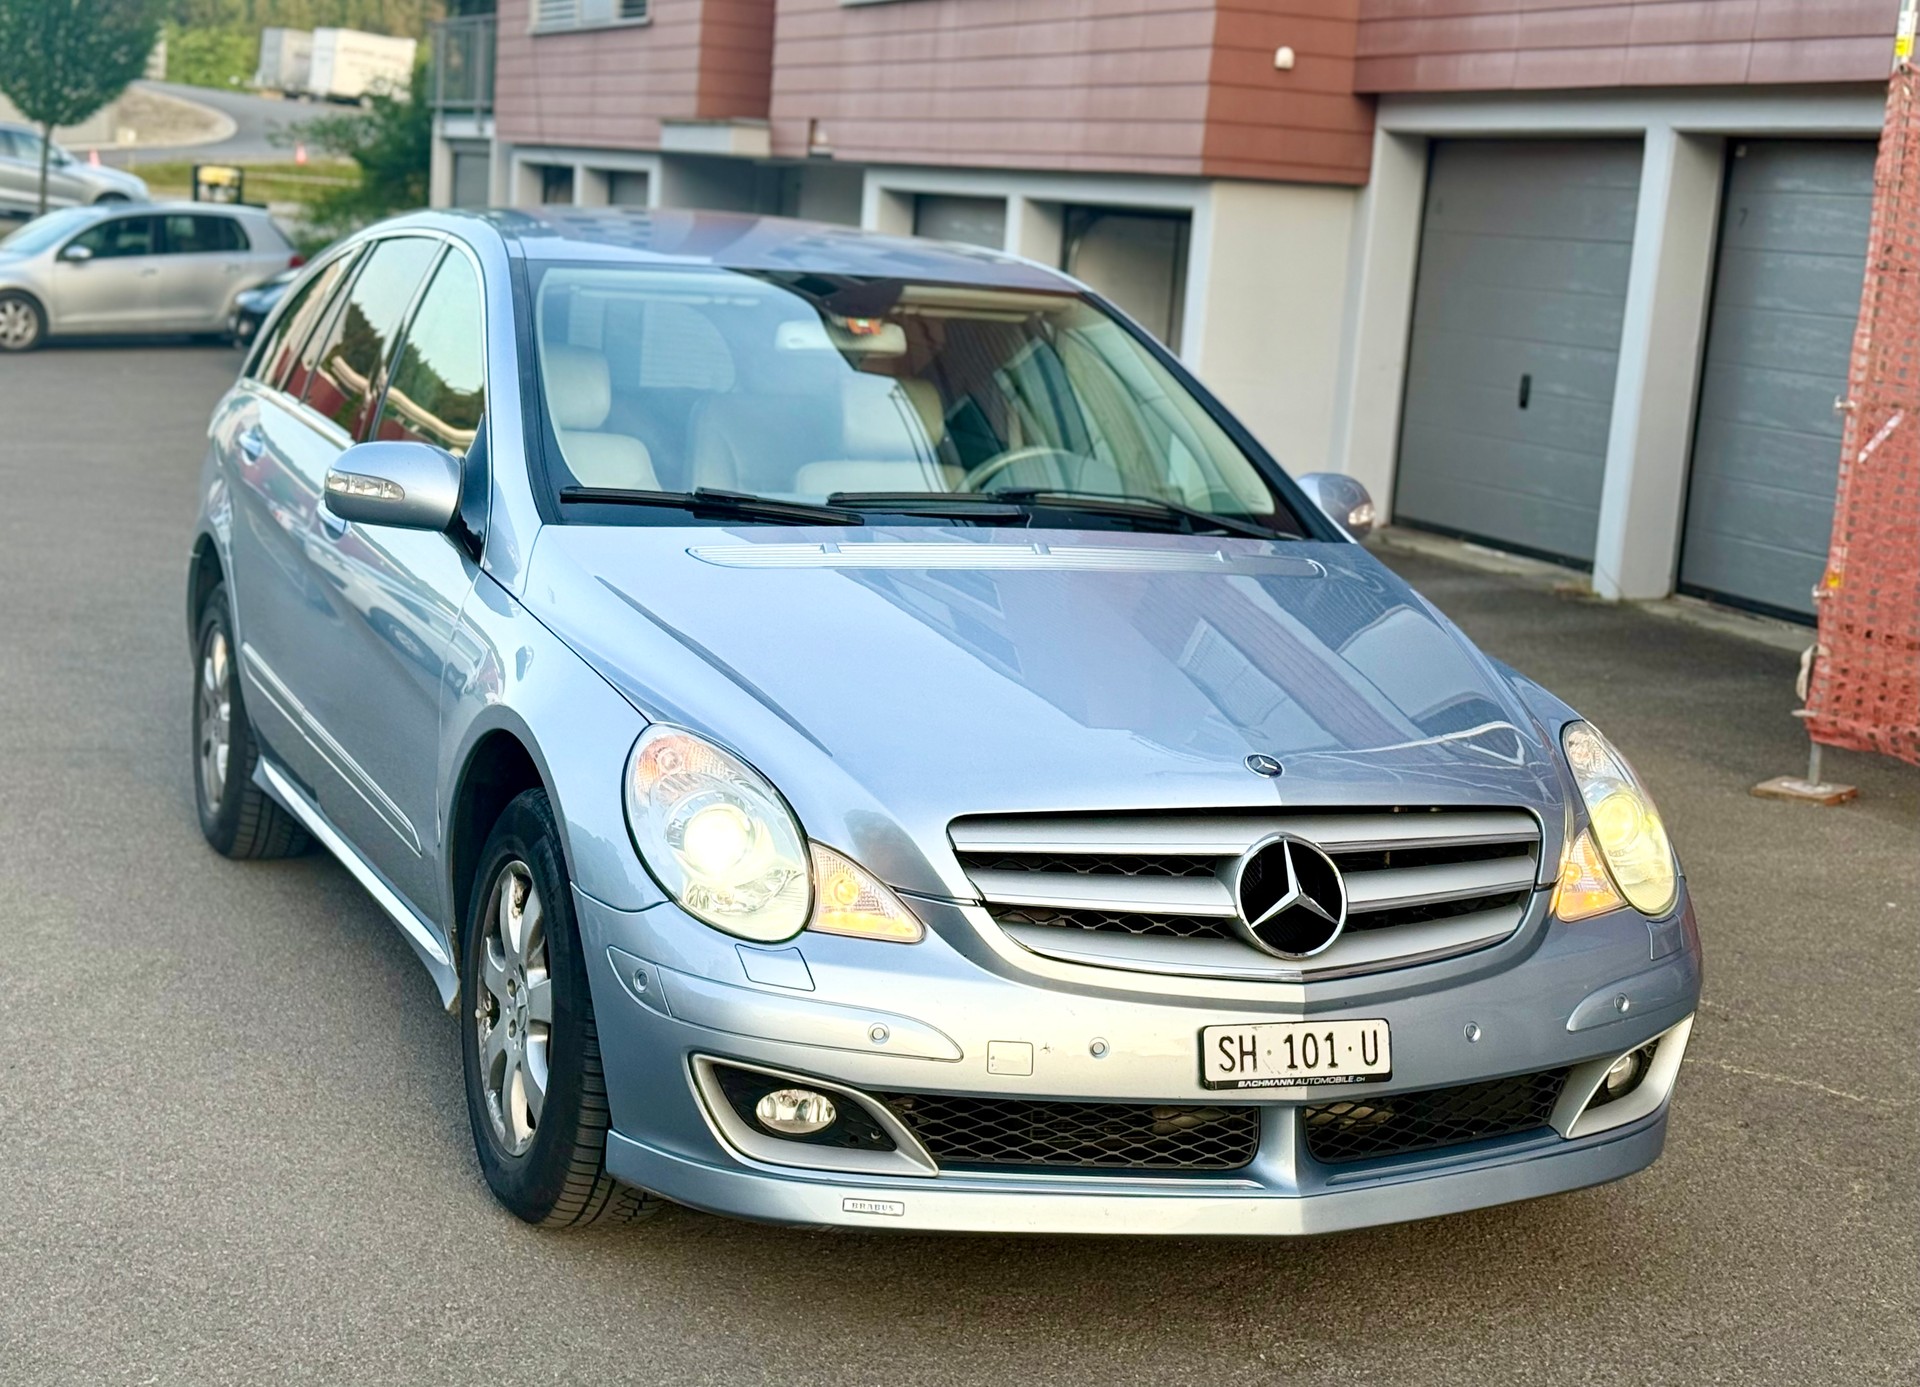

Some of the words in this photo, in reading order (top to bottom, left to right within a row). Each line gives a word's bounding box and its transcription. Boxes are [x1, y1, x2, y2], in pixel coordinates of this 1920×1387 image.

[1218, 1035, 1257, 1073] SH
[1284, 1032, 1338, 1070] 101
[1361, 1029, 1379, 1067] U
[1237, 1078, 1295, 1088] BACHMANN
[851, 1202, 895, 1212] BRABUS
